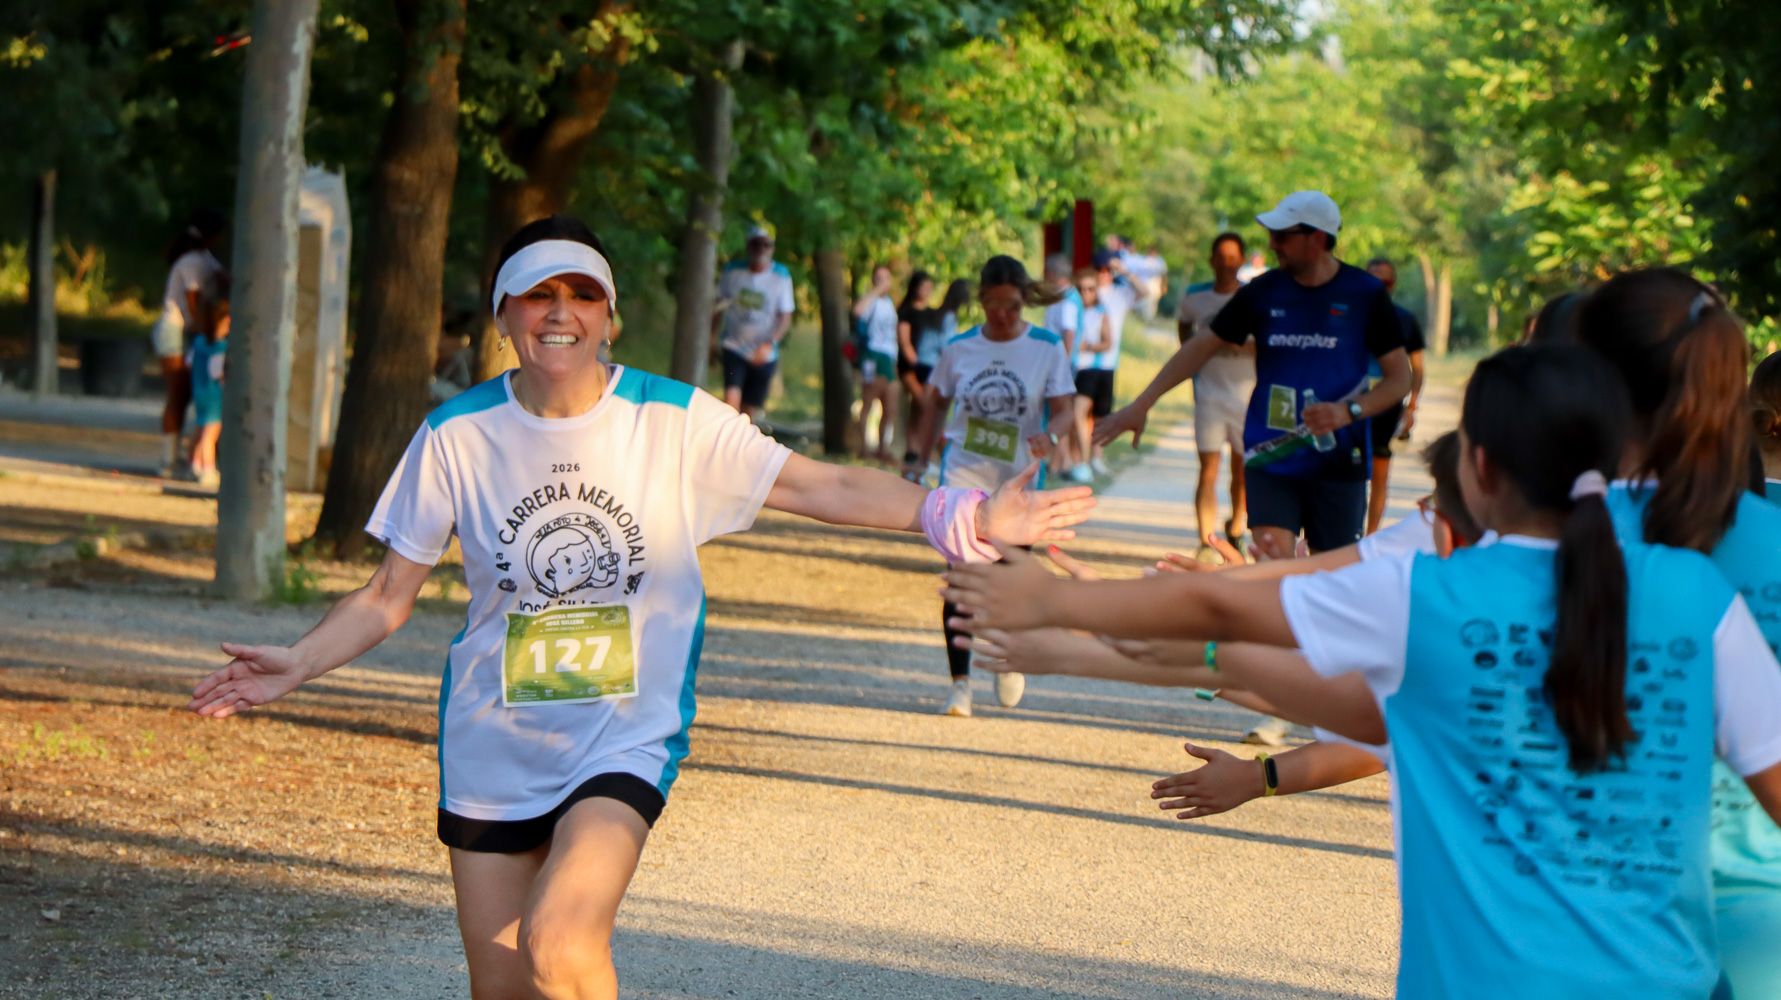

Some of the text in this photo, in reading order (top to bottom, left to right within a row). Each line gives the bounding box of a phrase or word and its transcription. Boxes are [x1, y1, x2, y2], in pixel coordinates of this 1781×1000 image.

[1268, 333, 1338, 349] enerplus
[975, 428, 1010, 450] 398
[551, 463, 580, 473] 2026
[498, 481, 571, 545] CARRERA
[577, 482, 645, 567] MEMORIAL
[529, 635, 612, 674] 127
